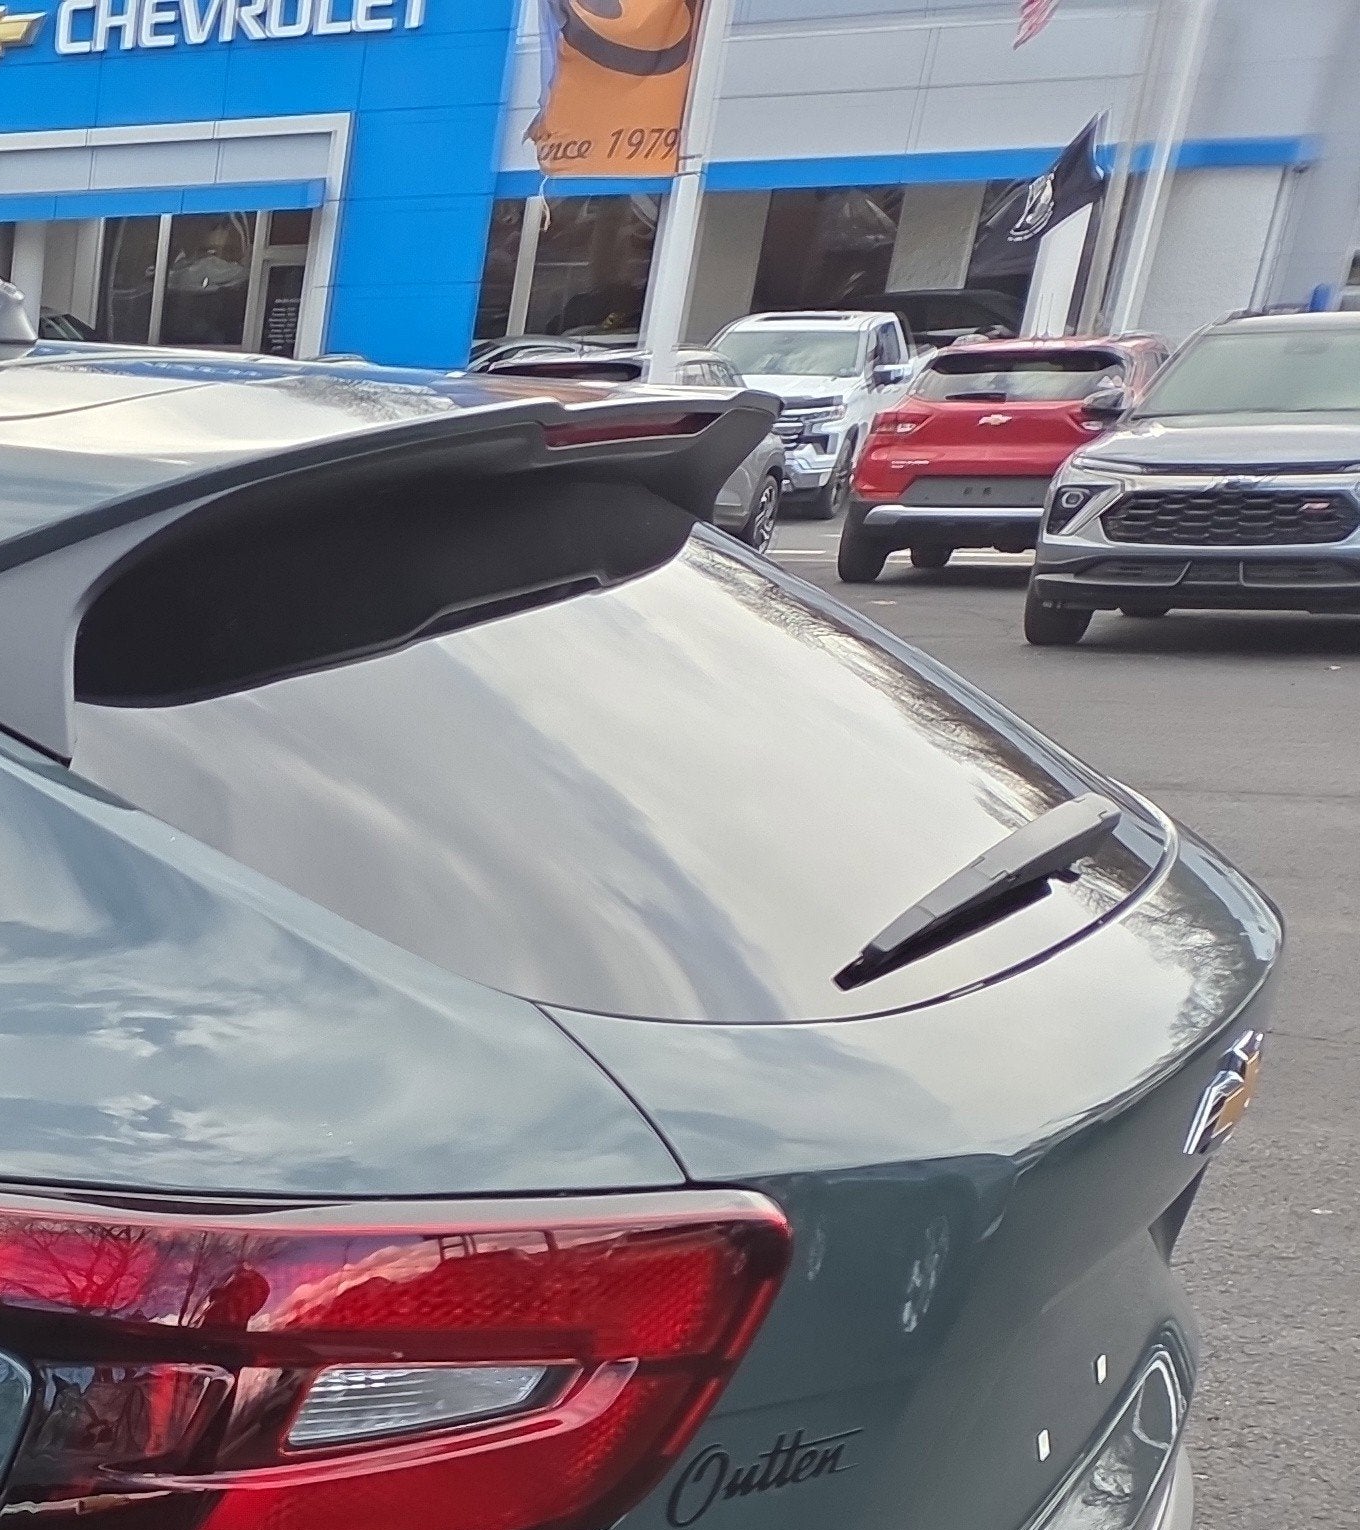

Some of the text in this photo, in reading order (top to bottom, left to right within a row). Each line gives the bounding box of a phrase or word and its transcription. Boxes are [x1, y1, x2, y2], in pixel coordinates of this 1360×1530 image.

[536, 127, 680, 161] ince 1979
[666, 1427, 864, 1528] Outten
